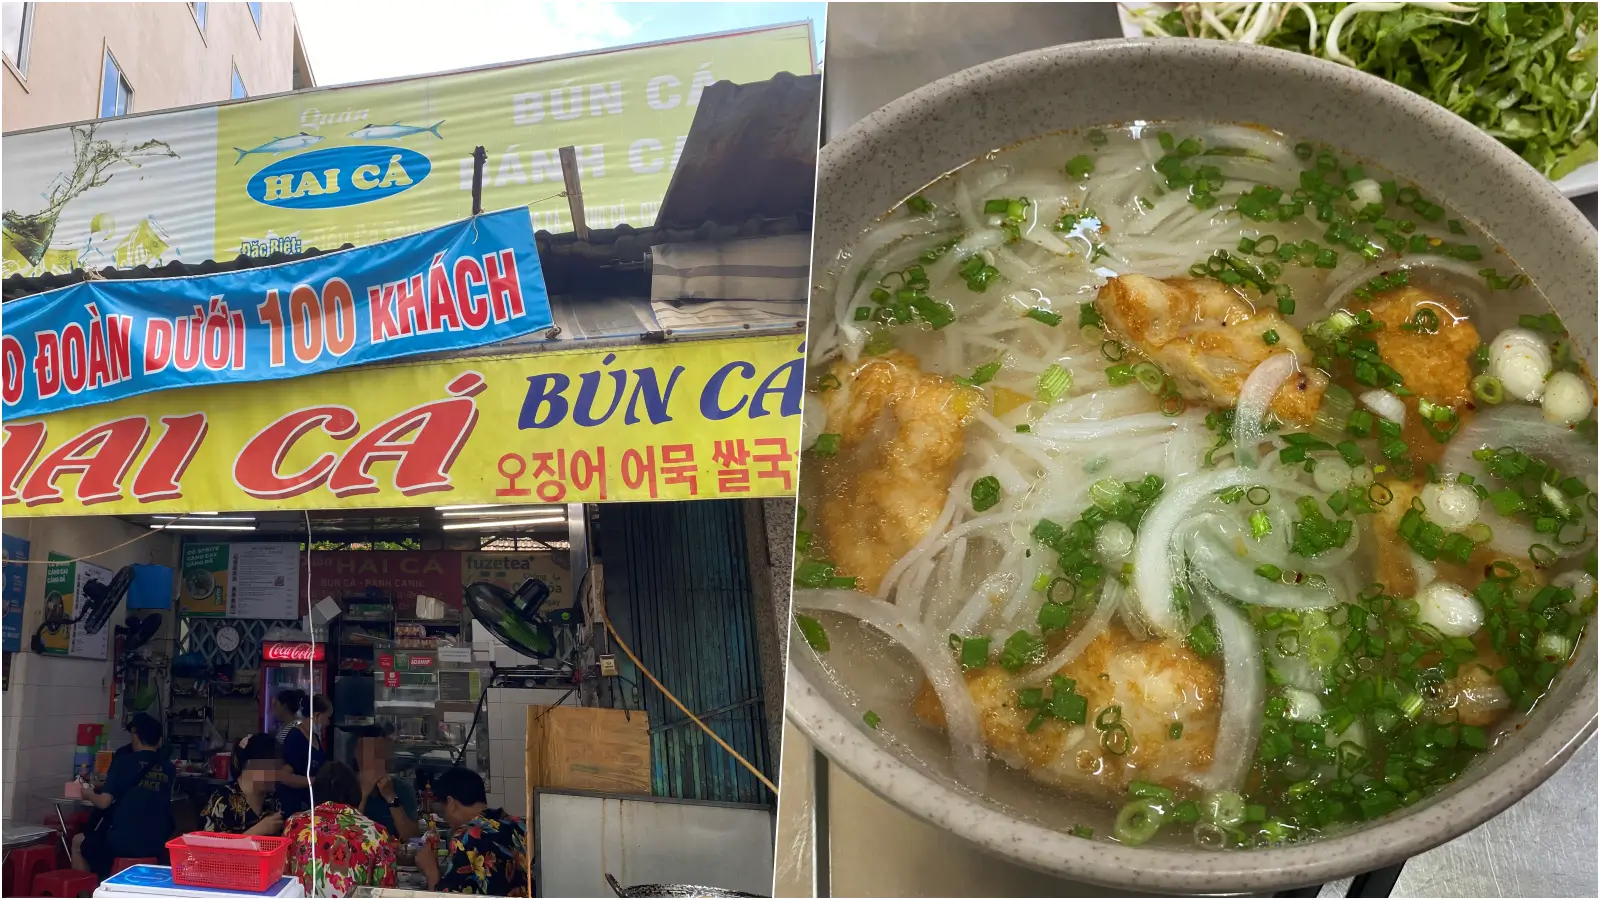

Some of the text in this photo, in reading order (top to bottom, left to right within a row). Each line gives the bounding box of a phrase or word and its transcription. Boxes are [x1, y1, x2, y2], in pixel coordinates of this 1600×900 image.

[300, 108, 370, 131] Quán
[513, 75, 624, 126] BÚN
[263, 154, 414, 201] HAI CÁ
[33, 301, 133, 400] ĐOÀN
[143, 294, 246, 373] DƯỚI
[258, 276, 357, 368] 100
[368, 248, 527, 345] KHÁCH
[517, 341, 806, 430] BÚN CÁ
[231, 370, 488, 501] CÁ
[495, 437, 800, 502] 오징어 어묵 쌀국
[336, 557, 389, 575] HAI
